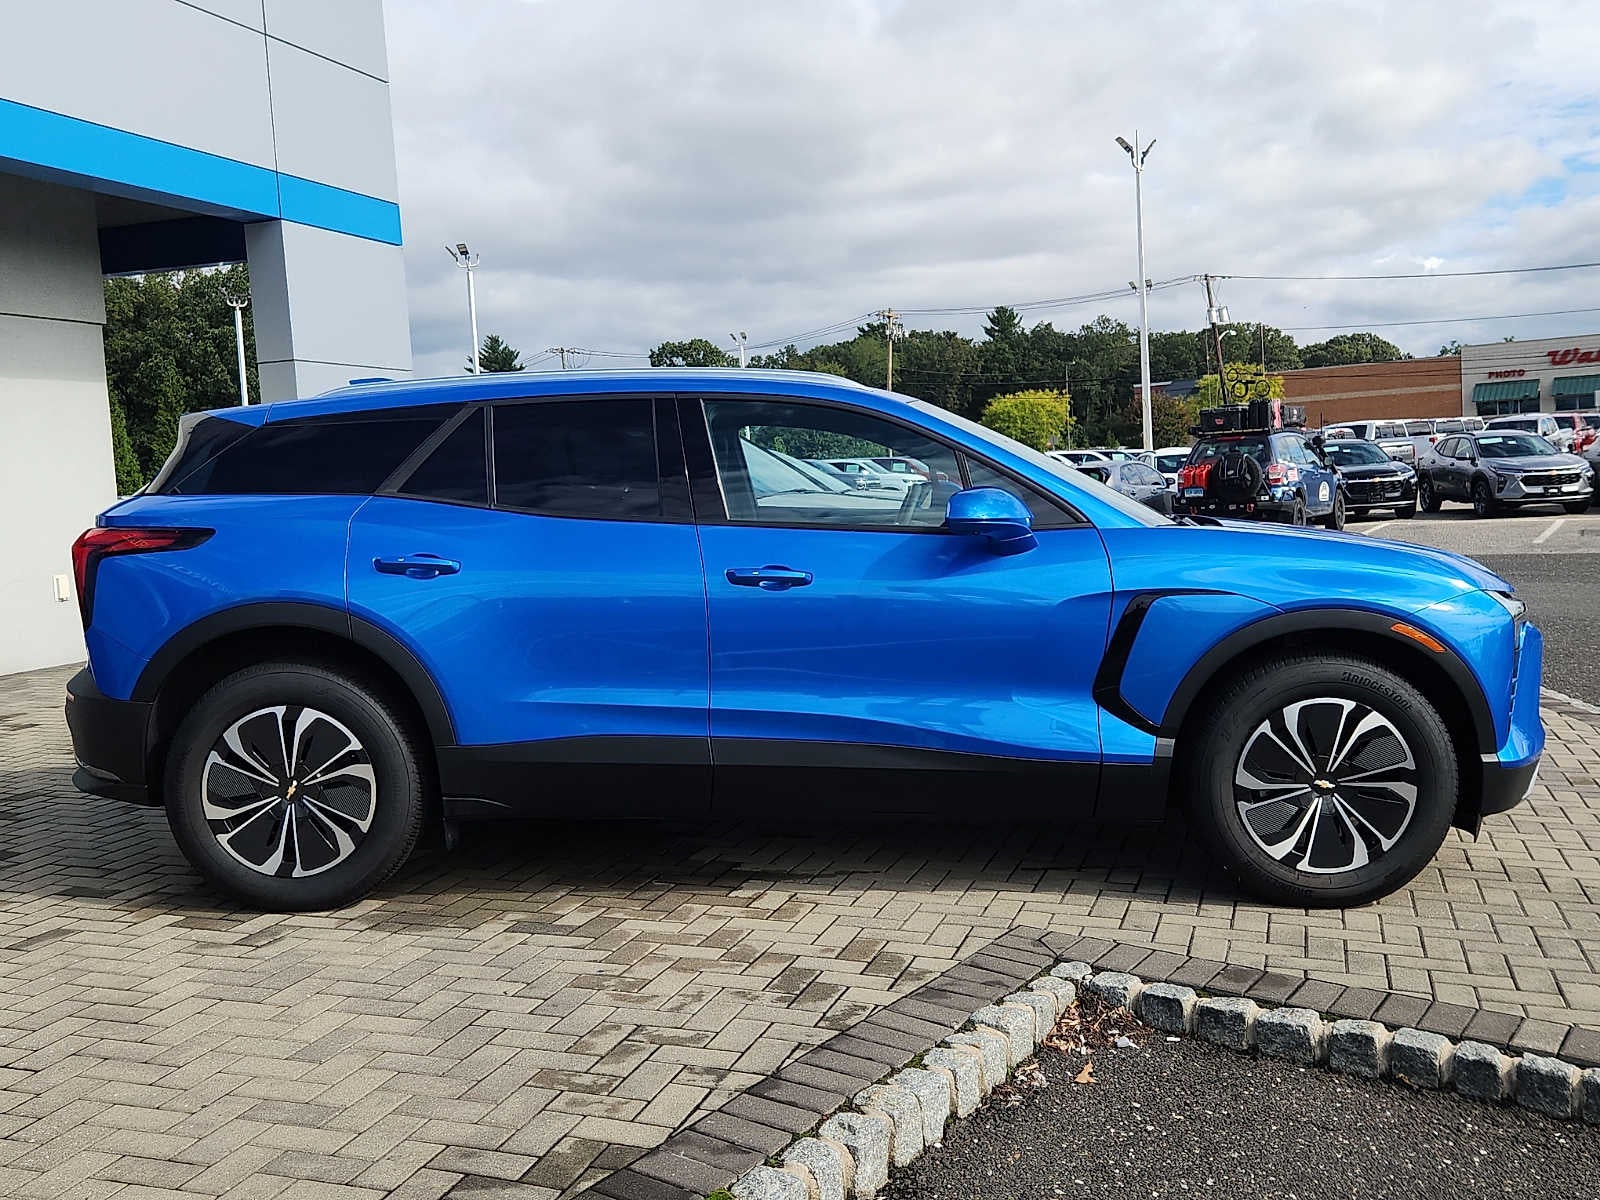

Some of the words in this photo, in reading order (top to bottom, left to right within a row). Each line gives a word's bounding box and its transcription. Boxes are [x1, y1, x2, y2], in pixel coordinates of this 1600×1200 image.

[1547, 347, 1600, 366] Wa
[1487, 369, 1526, 379] PHOTO
[1342, 671, 1414, 711] BRIDGESTONE
